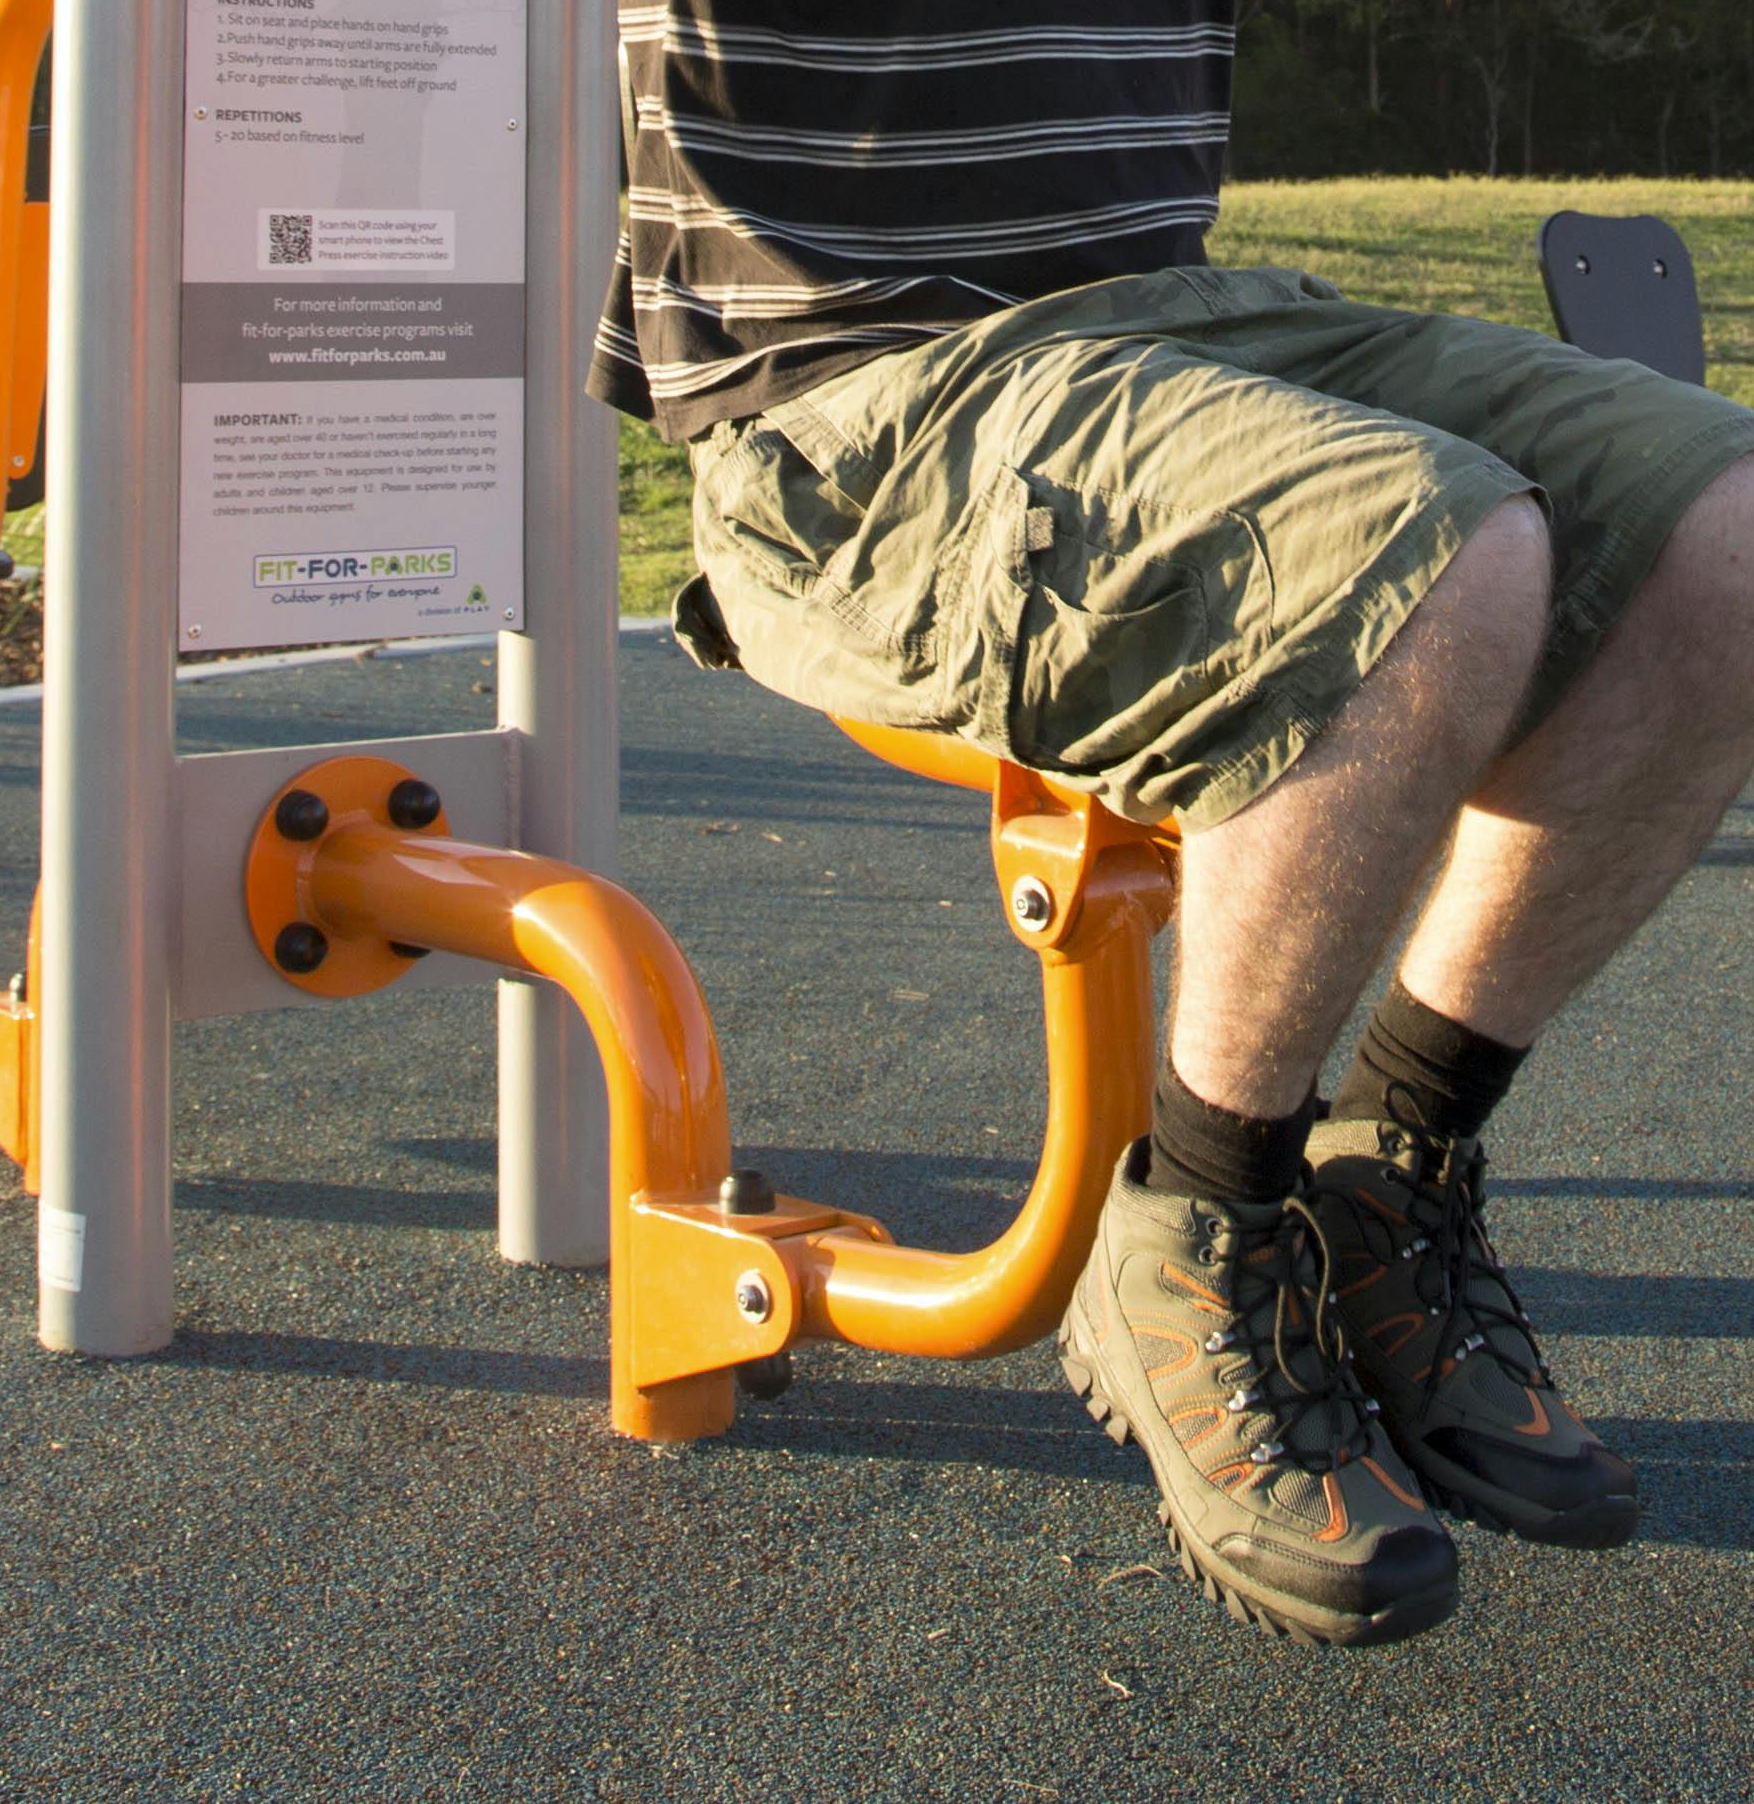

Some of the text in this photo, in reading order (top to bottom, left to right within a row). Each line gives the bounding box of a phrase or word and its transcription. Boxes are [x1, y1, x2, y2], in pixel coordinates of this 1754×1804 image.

[228, 12, 243, 25] Sit
[245, 16, 260, 26] on
[263, 16, 286, 28] seat
[288, 16, 308, 28] and
[310, 17, 340, 30] place
[342, 19, 375, 31] hands
[377, 22, 391, 32] on
[393, 21, 420, 34] hand
[421, 23, 449, 37] grips
[257, 33, 285, 46] hand
[287, 36, 315, 50] grips
[316, 38, 345, 51] away
[347, 39, 372, 50] until
[374, 41, 401, 51] arms
[404, 43, 421, 52] are
[423, 41, 445, 56] fully
[447, 44, 497, 56] extended
[266, 54, 303, 66] return
[305, 57, 333, 67] arms
[335, 57, 346, 68] to
[348, 58, 392, 73] starting
[393, 60, 437, 73] position
[249, 75, 256, 84] a
[257, 75, 299, 87] greater
[359, 76, 374, 88] lift
[376, 77, 398, 89] feet
[399, 77, 416, 89] off
[417, 80, 457, 93] ground
[215, 109, 302, 123] REPETITIONS
[247, 129, 281, 142] based
[283, 132, 297, 142] on
[299, 130, 337, 144] fitness
[339, 132, 365, 144] level
[318, 220, 437, 232] Scan this QR code using your
[318, 235, 444, 247] smart phone to view the Chest
[318, 250, 449, 260] Press exercise instruction video
[274, 298, 442, 312] For more information and
[242, 322, 474, 341] fit-for-parks exercise programs visit
[269, 348, 446, 366] www.fitforparks.com.au
[214, 413, 302, 427] IMPORTANT:
[316, 416, 334, 426] you
[338, 415, 360, 424] have
[373, 414, 408, 423] medical
[476, 413, 496, 421] over
[249, 436, 265, 444] are
[266, 434, 291, 445] aged
[292, 435, 313, 443] over
[329, 434, 338, 442] or
[376, 431, 419, 440] exercised
[420, 430, 458, 441] regularly
[459, 430, 467, 438] in
[470, 430, 476, 438] a
[477, 429, 497, 440] long
[239, 454, 256, 462] see
[258, 453, 278, 463] your
[280, 452, 311, 461] doctor
[312, 451, 325, 460] for
[335, 450, 371, 459] medical
[416, 447, 444, 457] before
[445, 446, 479, 457] starting
[481, 447, 497, 457] any
[213, 472, 233, 480] new
[236, 471, 276, 479] exercise
[323, 467, 343, 477] This
[346, 467, 394, 477] equipment
[396, 466, 405, 475] is
[408, 464, 449, 476] designed
[451, 463, 464, 473] for
[466, 464, 482, 473] use
[485, 462, 497, 474] by
[213, 504, 250, 516] children
[252, 504, 285, 515] around
[286, 503, 303, 514] this
[259, 553, 452, 581] FIT-FOR-PARKS
[271, 585, 441, 606] Outdoor gyms for everyone
